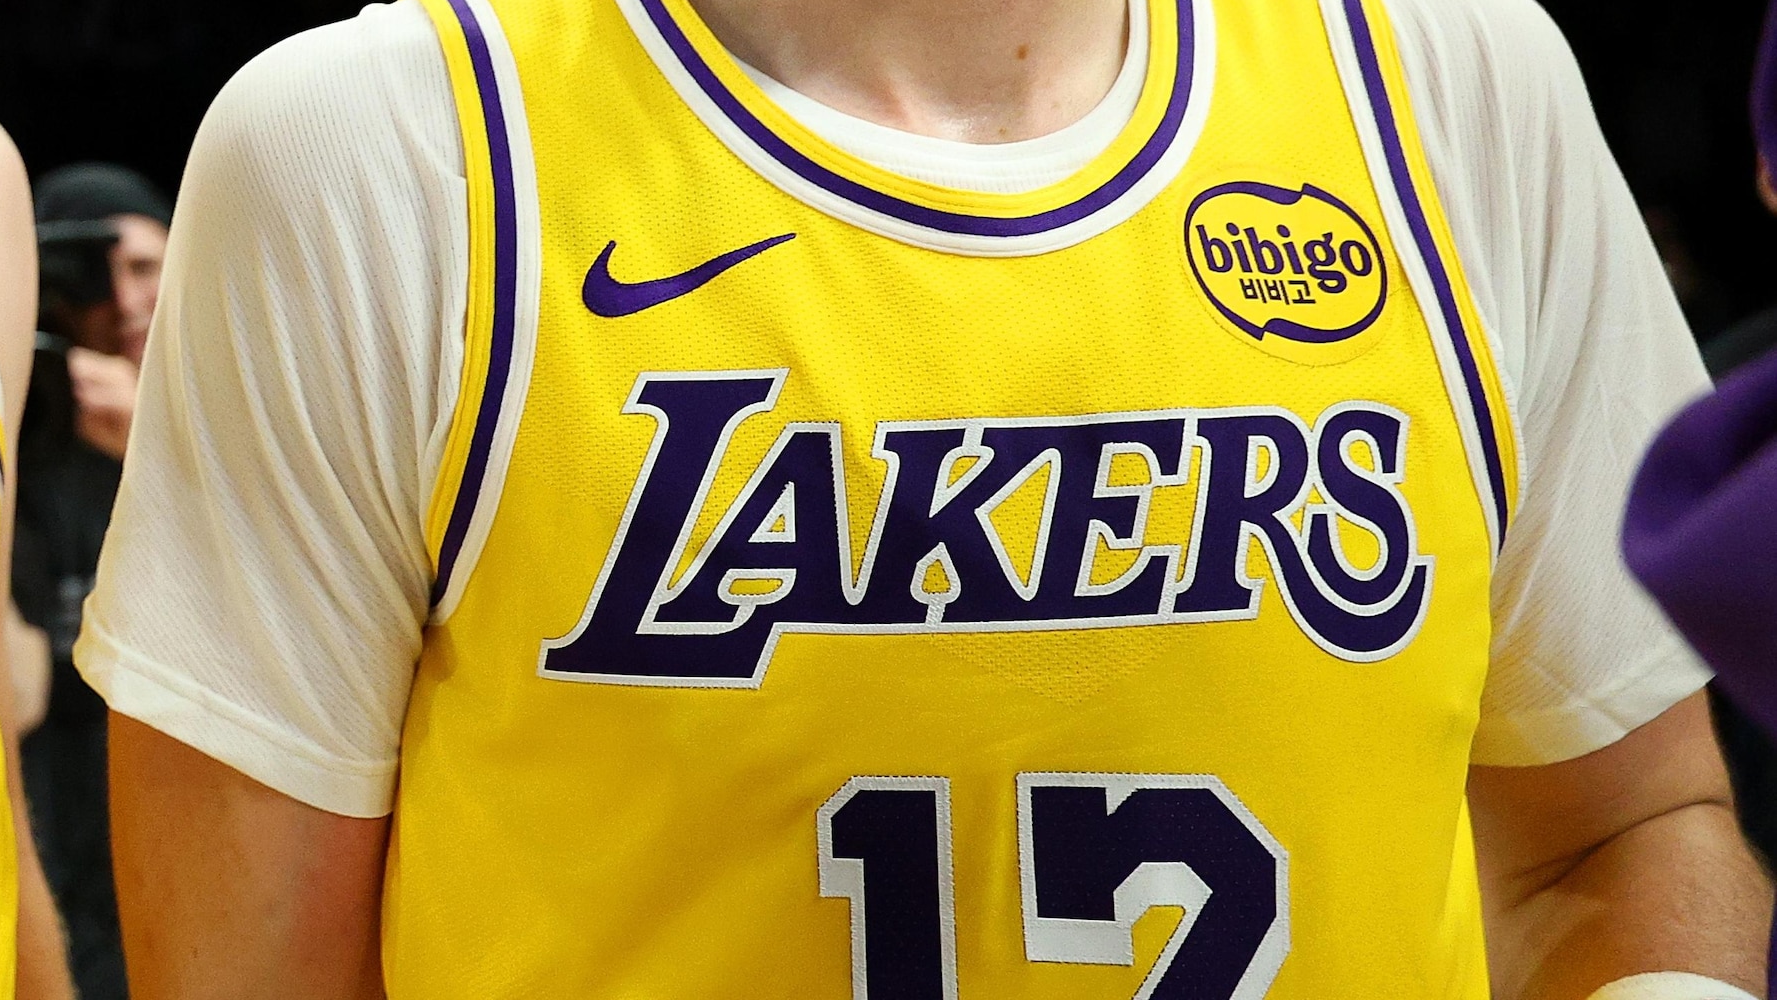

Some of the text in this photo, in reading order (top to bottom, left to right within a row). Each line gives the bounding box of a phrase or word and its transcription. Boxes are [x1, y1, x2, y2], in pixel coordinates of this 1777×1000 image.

[1195, 222, 1374, 294] bibigo
[1239, 278, 1317, 306] 비비고
[537, 367, 1435, 690] LAKERS
